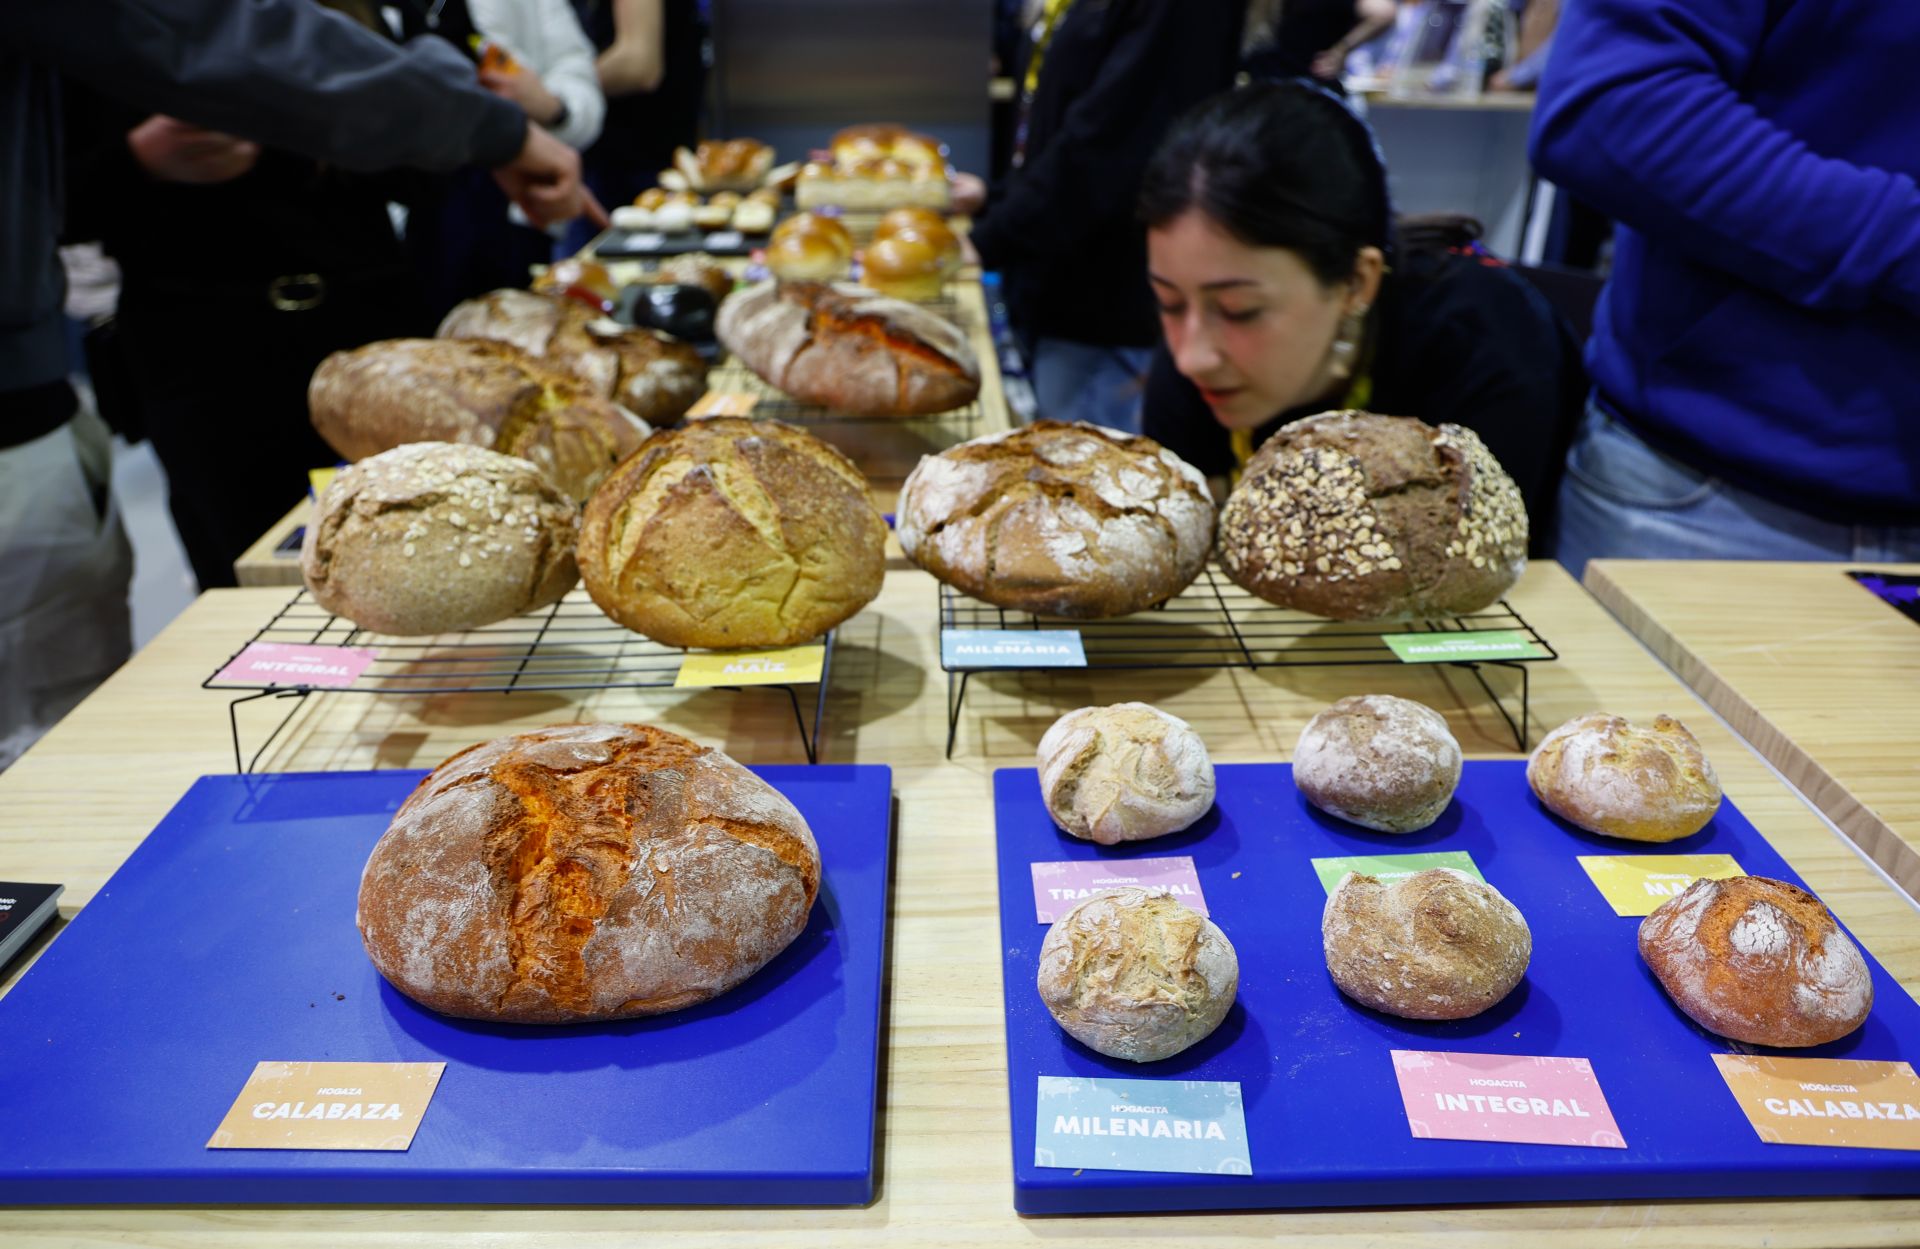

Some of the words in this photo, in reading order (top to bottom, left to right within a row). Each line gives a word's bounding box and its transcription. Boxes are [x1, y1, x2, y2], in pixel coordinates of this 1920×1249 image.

[956, 645, 1071, 654] MILENARIA
[250, 660, 349, 676] INTEGRAL
[1469, 1077, 1527, 1089] HOGACITA
[1799, 1083, 1859, 1093] HOGACITA
[317, 1087, 363, 1096] HOGAZA
[1111, 1104, 1169, 1115] HOGACITA
[1434, 1092, 1590, 1118] INTEGRAL
[252, 1102, 404, 1121] CALABAZA
[1053, 1115, 1226, 1141] MILENARIA
